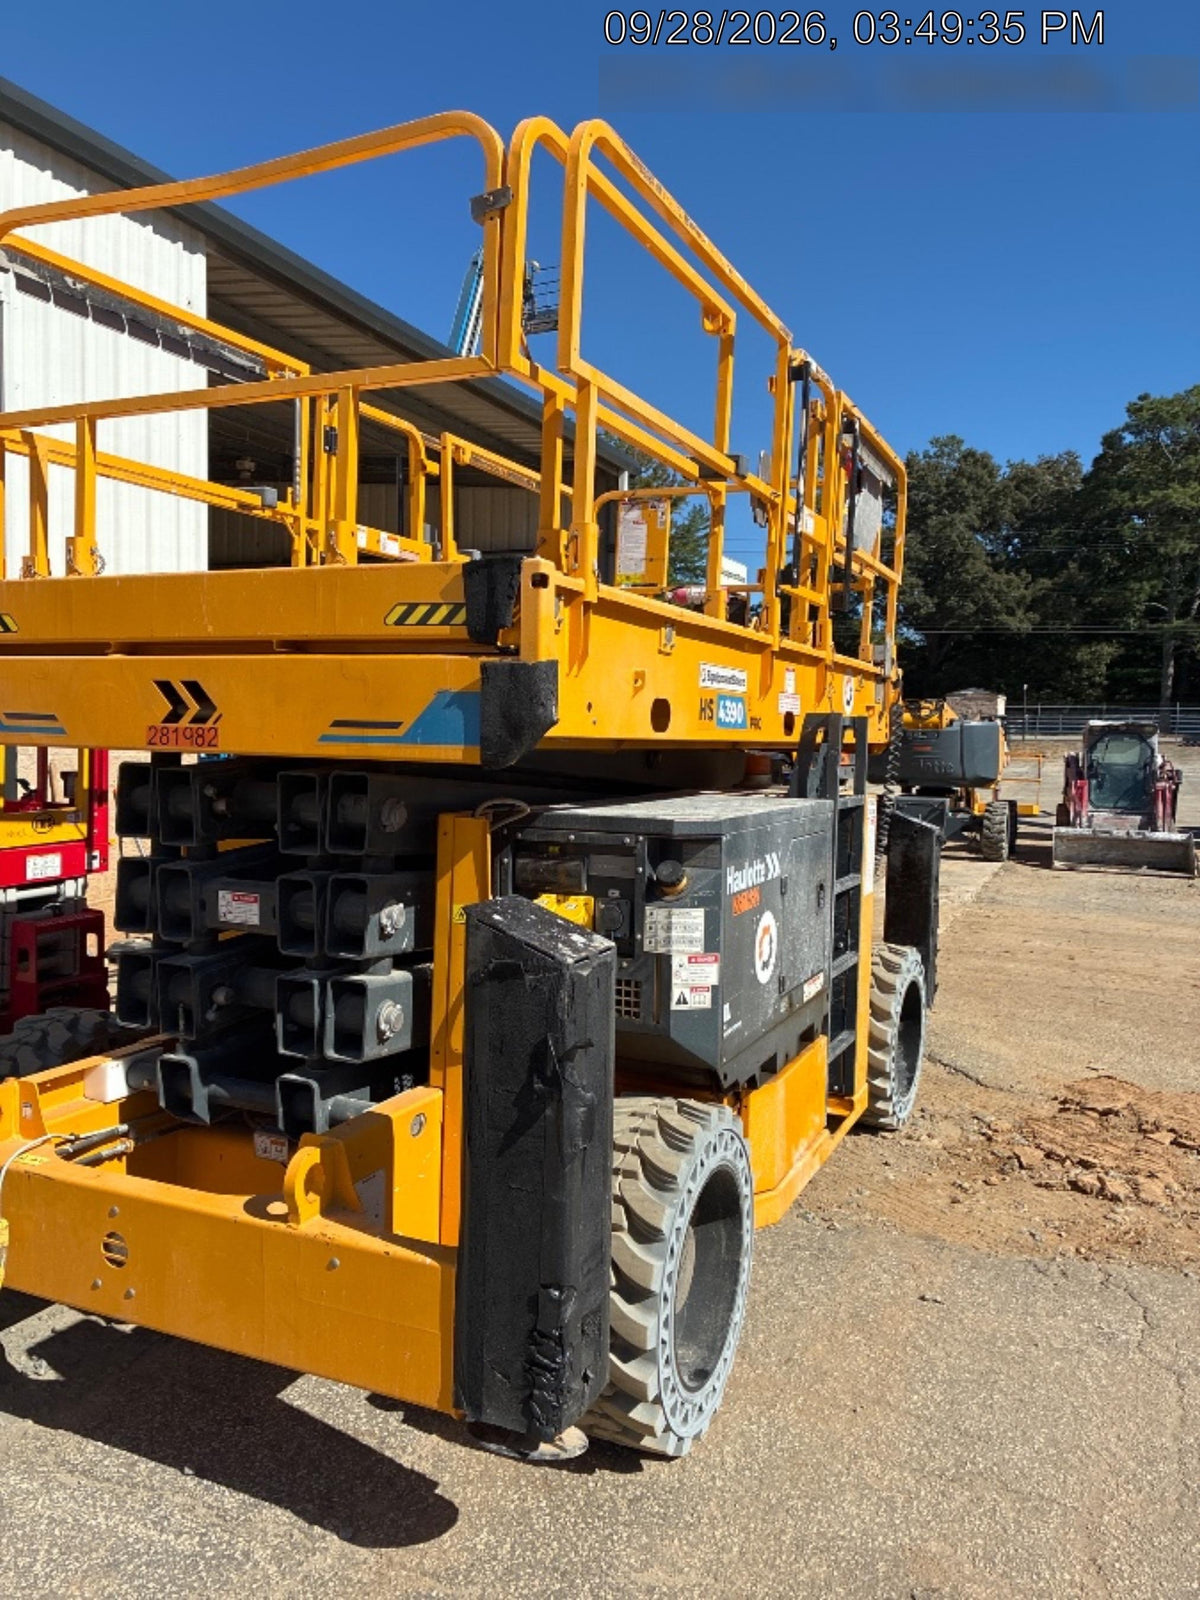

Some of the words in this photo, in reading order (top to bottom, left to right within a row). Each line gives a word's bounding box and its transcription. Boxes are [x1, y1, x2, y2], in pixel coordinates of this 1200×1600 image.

[699, 698, 714, 721] HS
[719, 699, 744, 724] 4390
[147, 725, 218, 747] 281982
[726, 858, 765, 895] Haulotte
